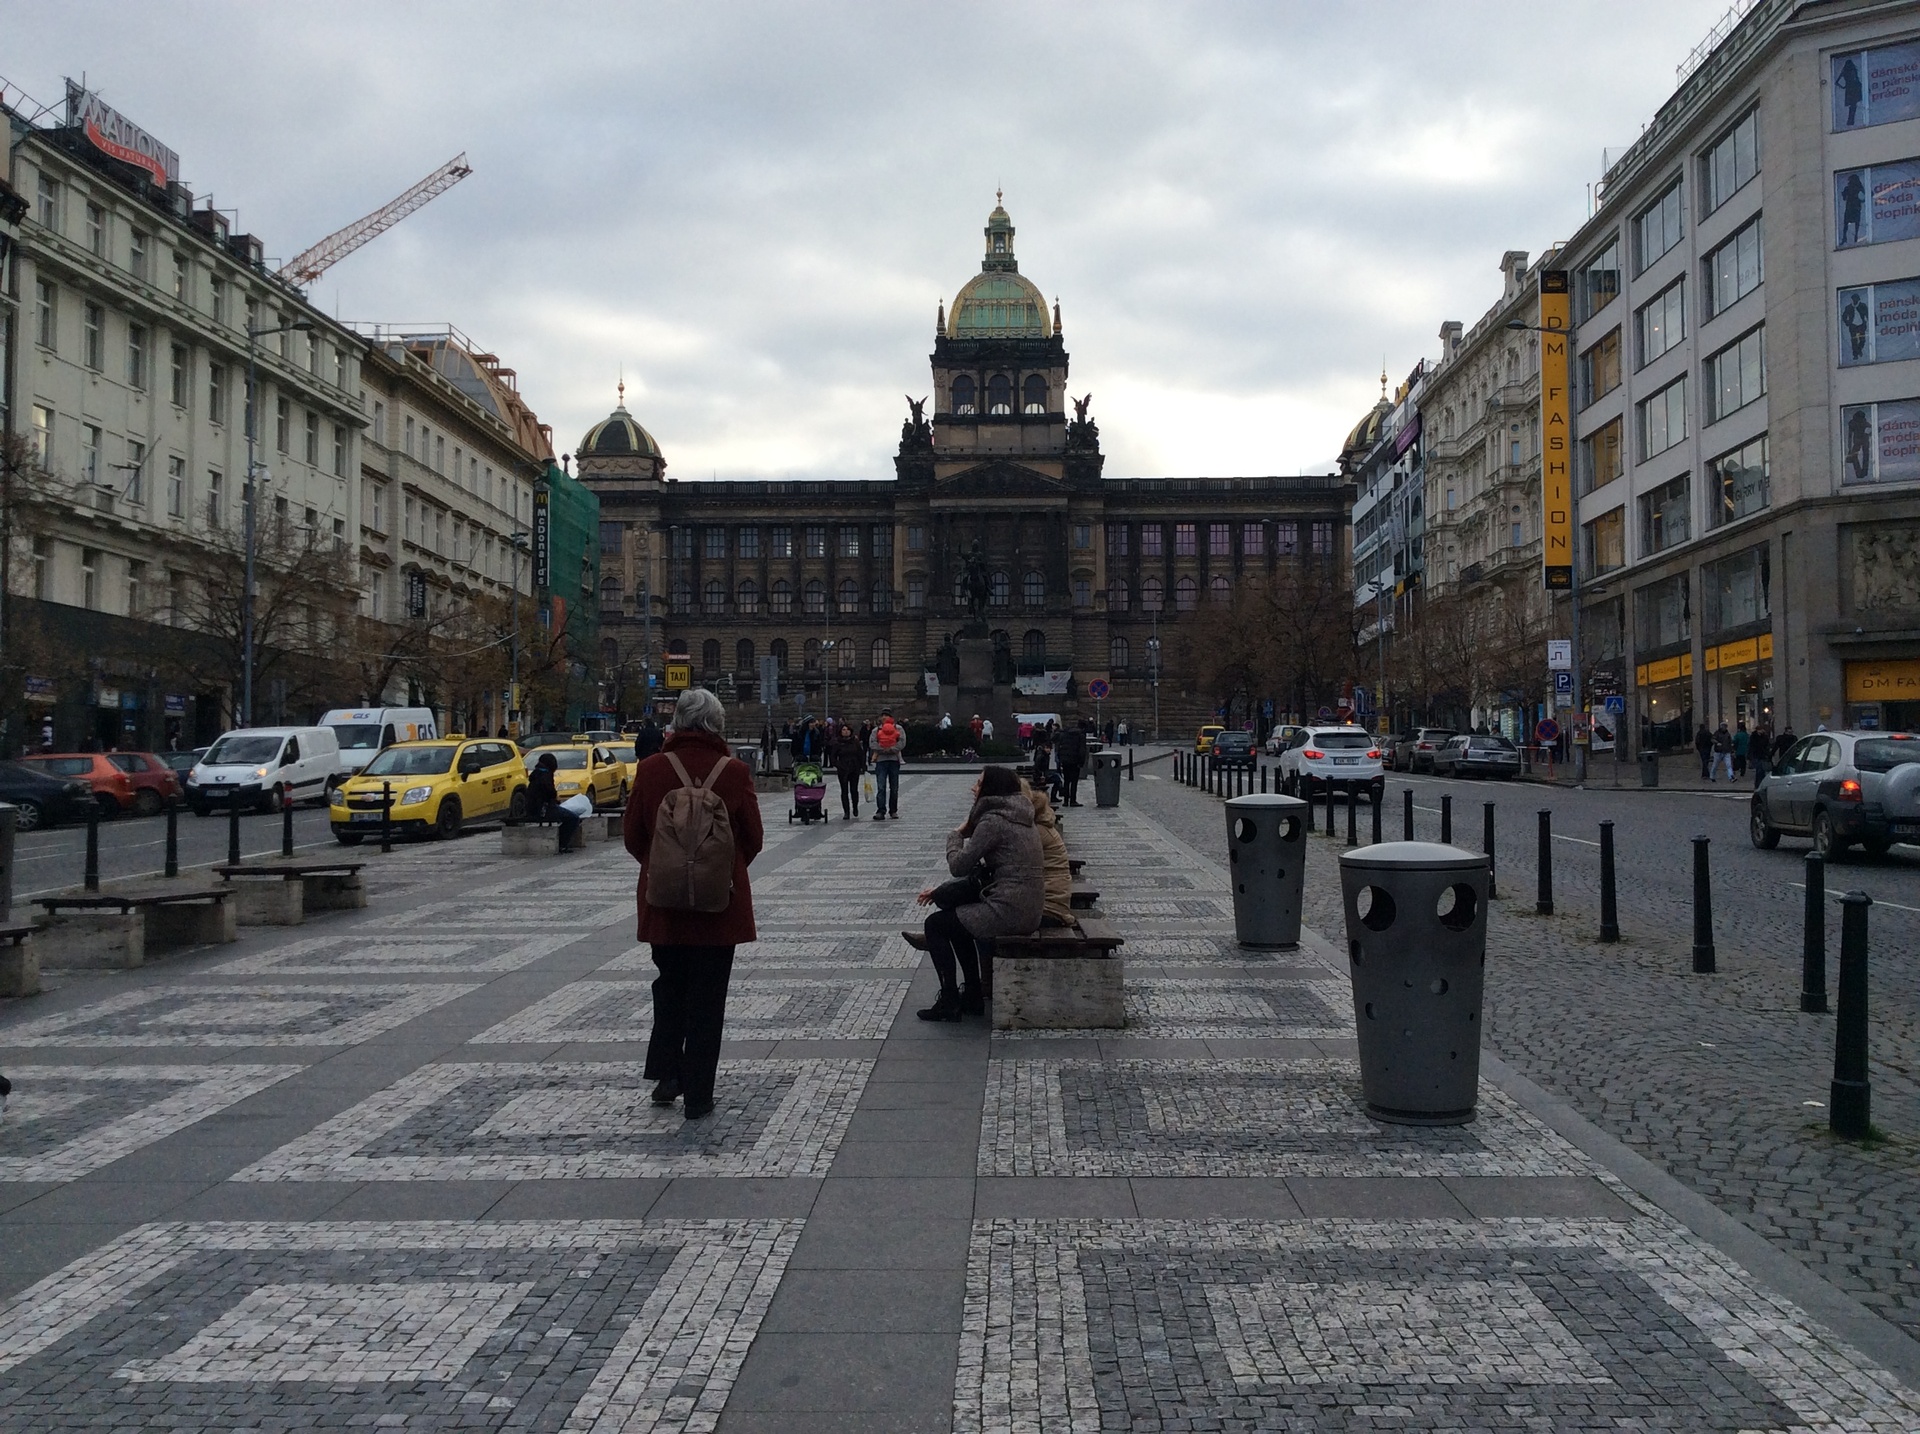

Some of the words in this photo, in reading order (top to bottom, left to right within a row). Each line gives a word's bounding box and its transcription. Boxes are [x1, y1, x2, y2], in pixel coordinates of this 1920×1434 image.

[1879, 309, 1918, 323] móda
[1549, 388, 1566, 548] FASHION
[537, 508, 547, 585] McDonald's
[670, 671, 686, 682] TAXI
[1558, 674, 1569, 687] P
[1862, 678, 1890, 689] DM
[1896, 677, 1920, 688] FA
[352, 712, 371, 720] GLS
[417, 723, 434, 741] GLS
